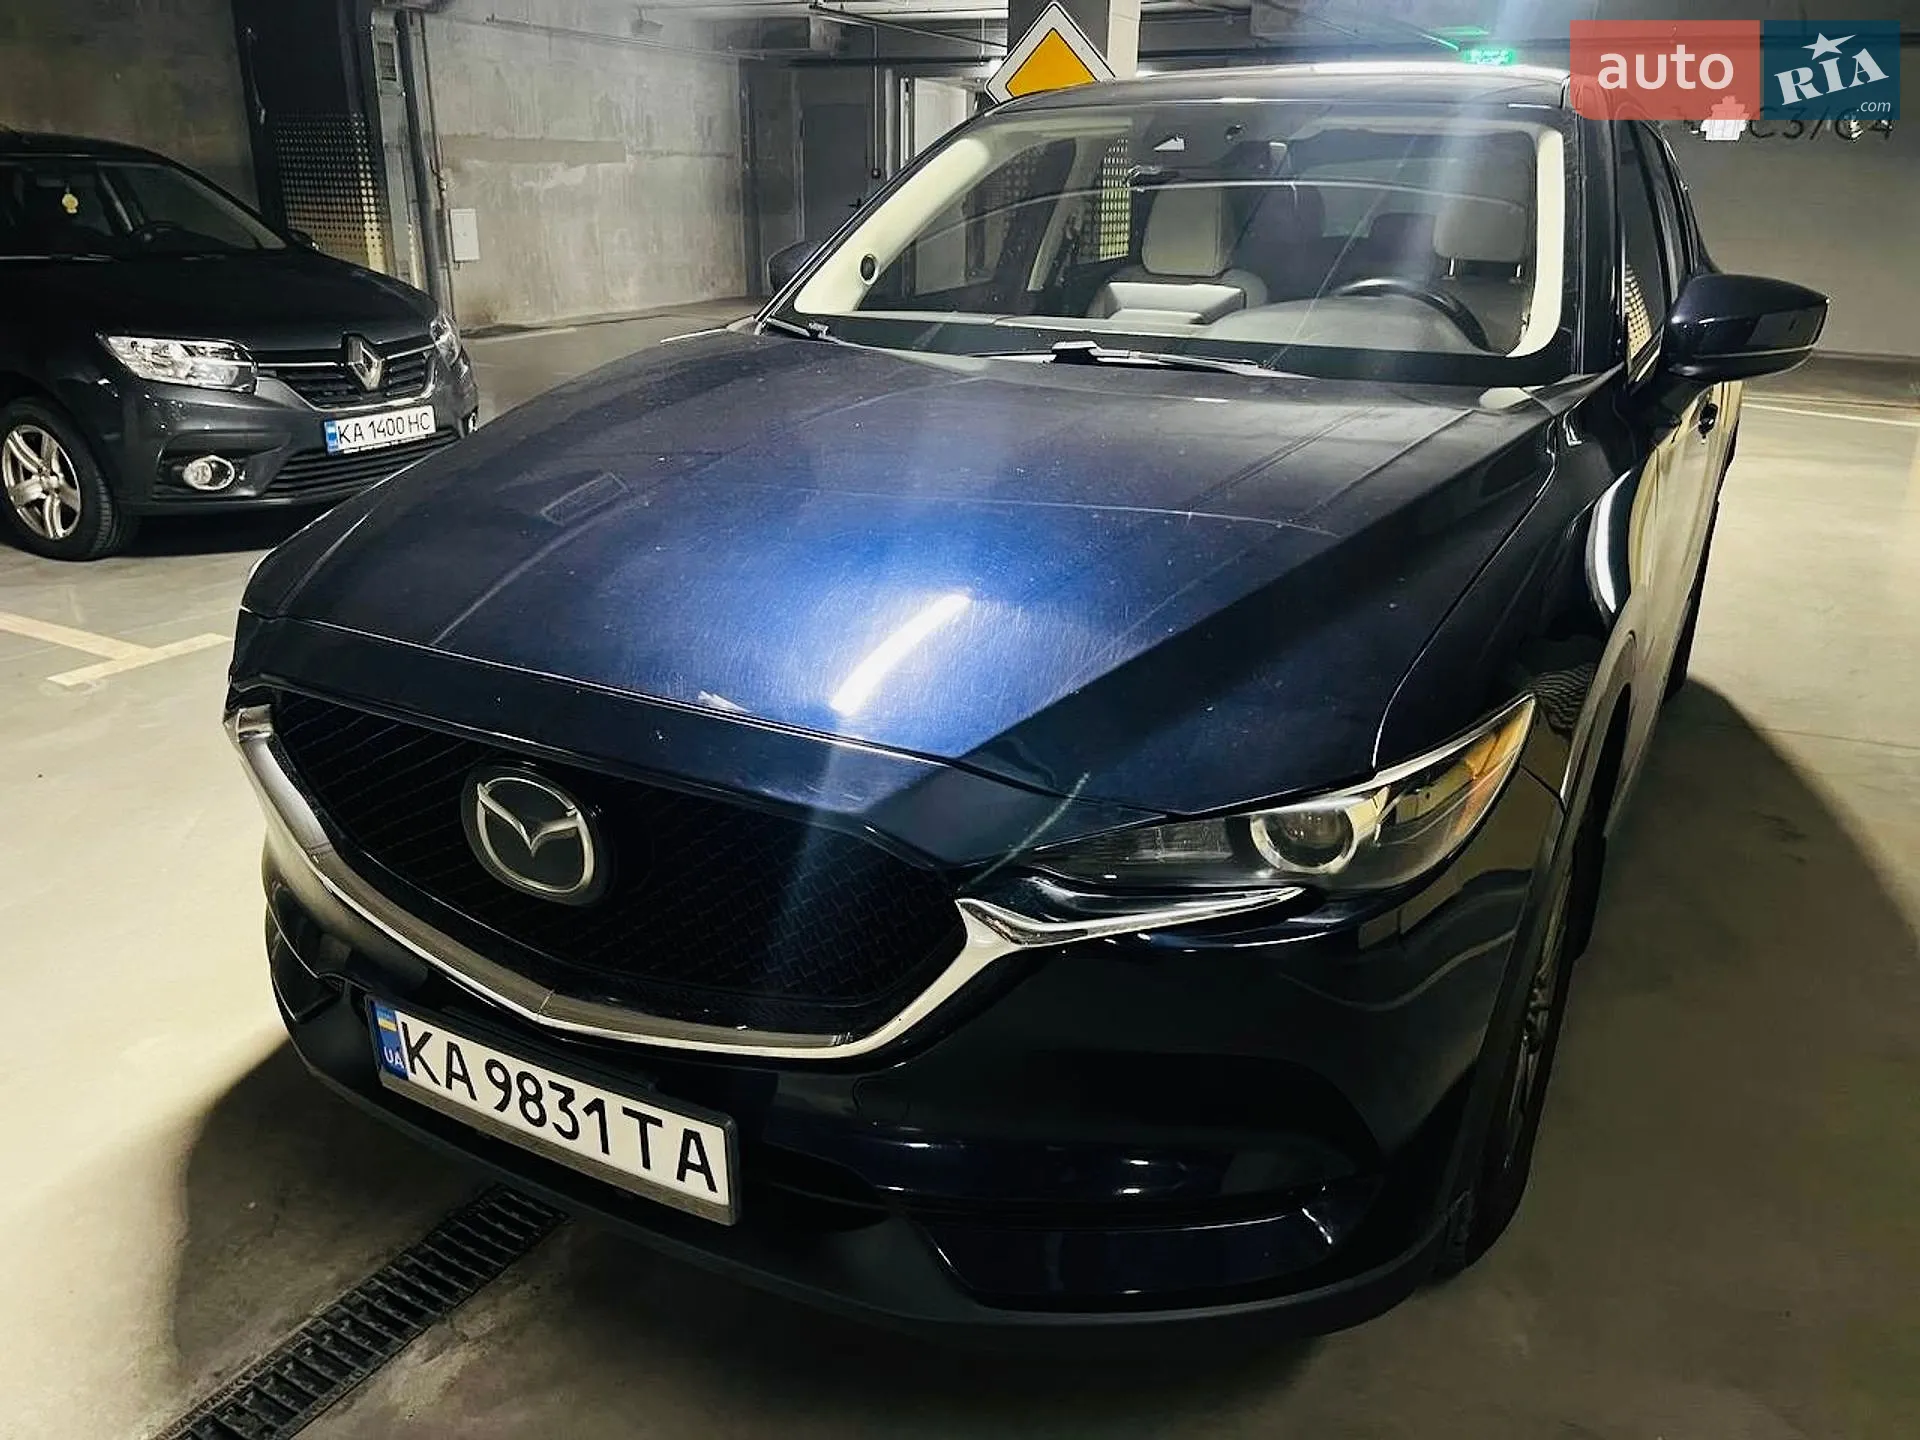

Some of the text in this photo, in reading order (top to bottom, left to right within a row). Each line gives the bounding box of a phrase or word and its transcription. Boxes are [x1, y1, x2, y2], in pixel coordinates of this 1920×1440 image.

[338, 412, 431, 444] KA 1400 HC
[384, 1046, 405, 1069] UA
[401, 1021, 718, 1193] KA 9831 TA
